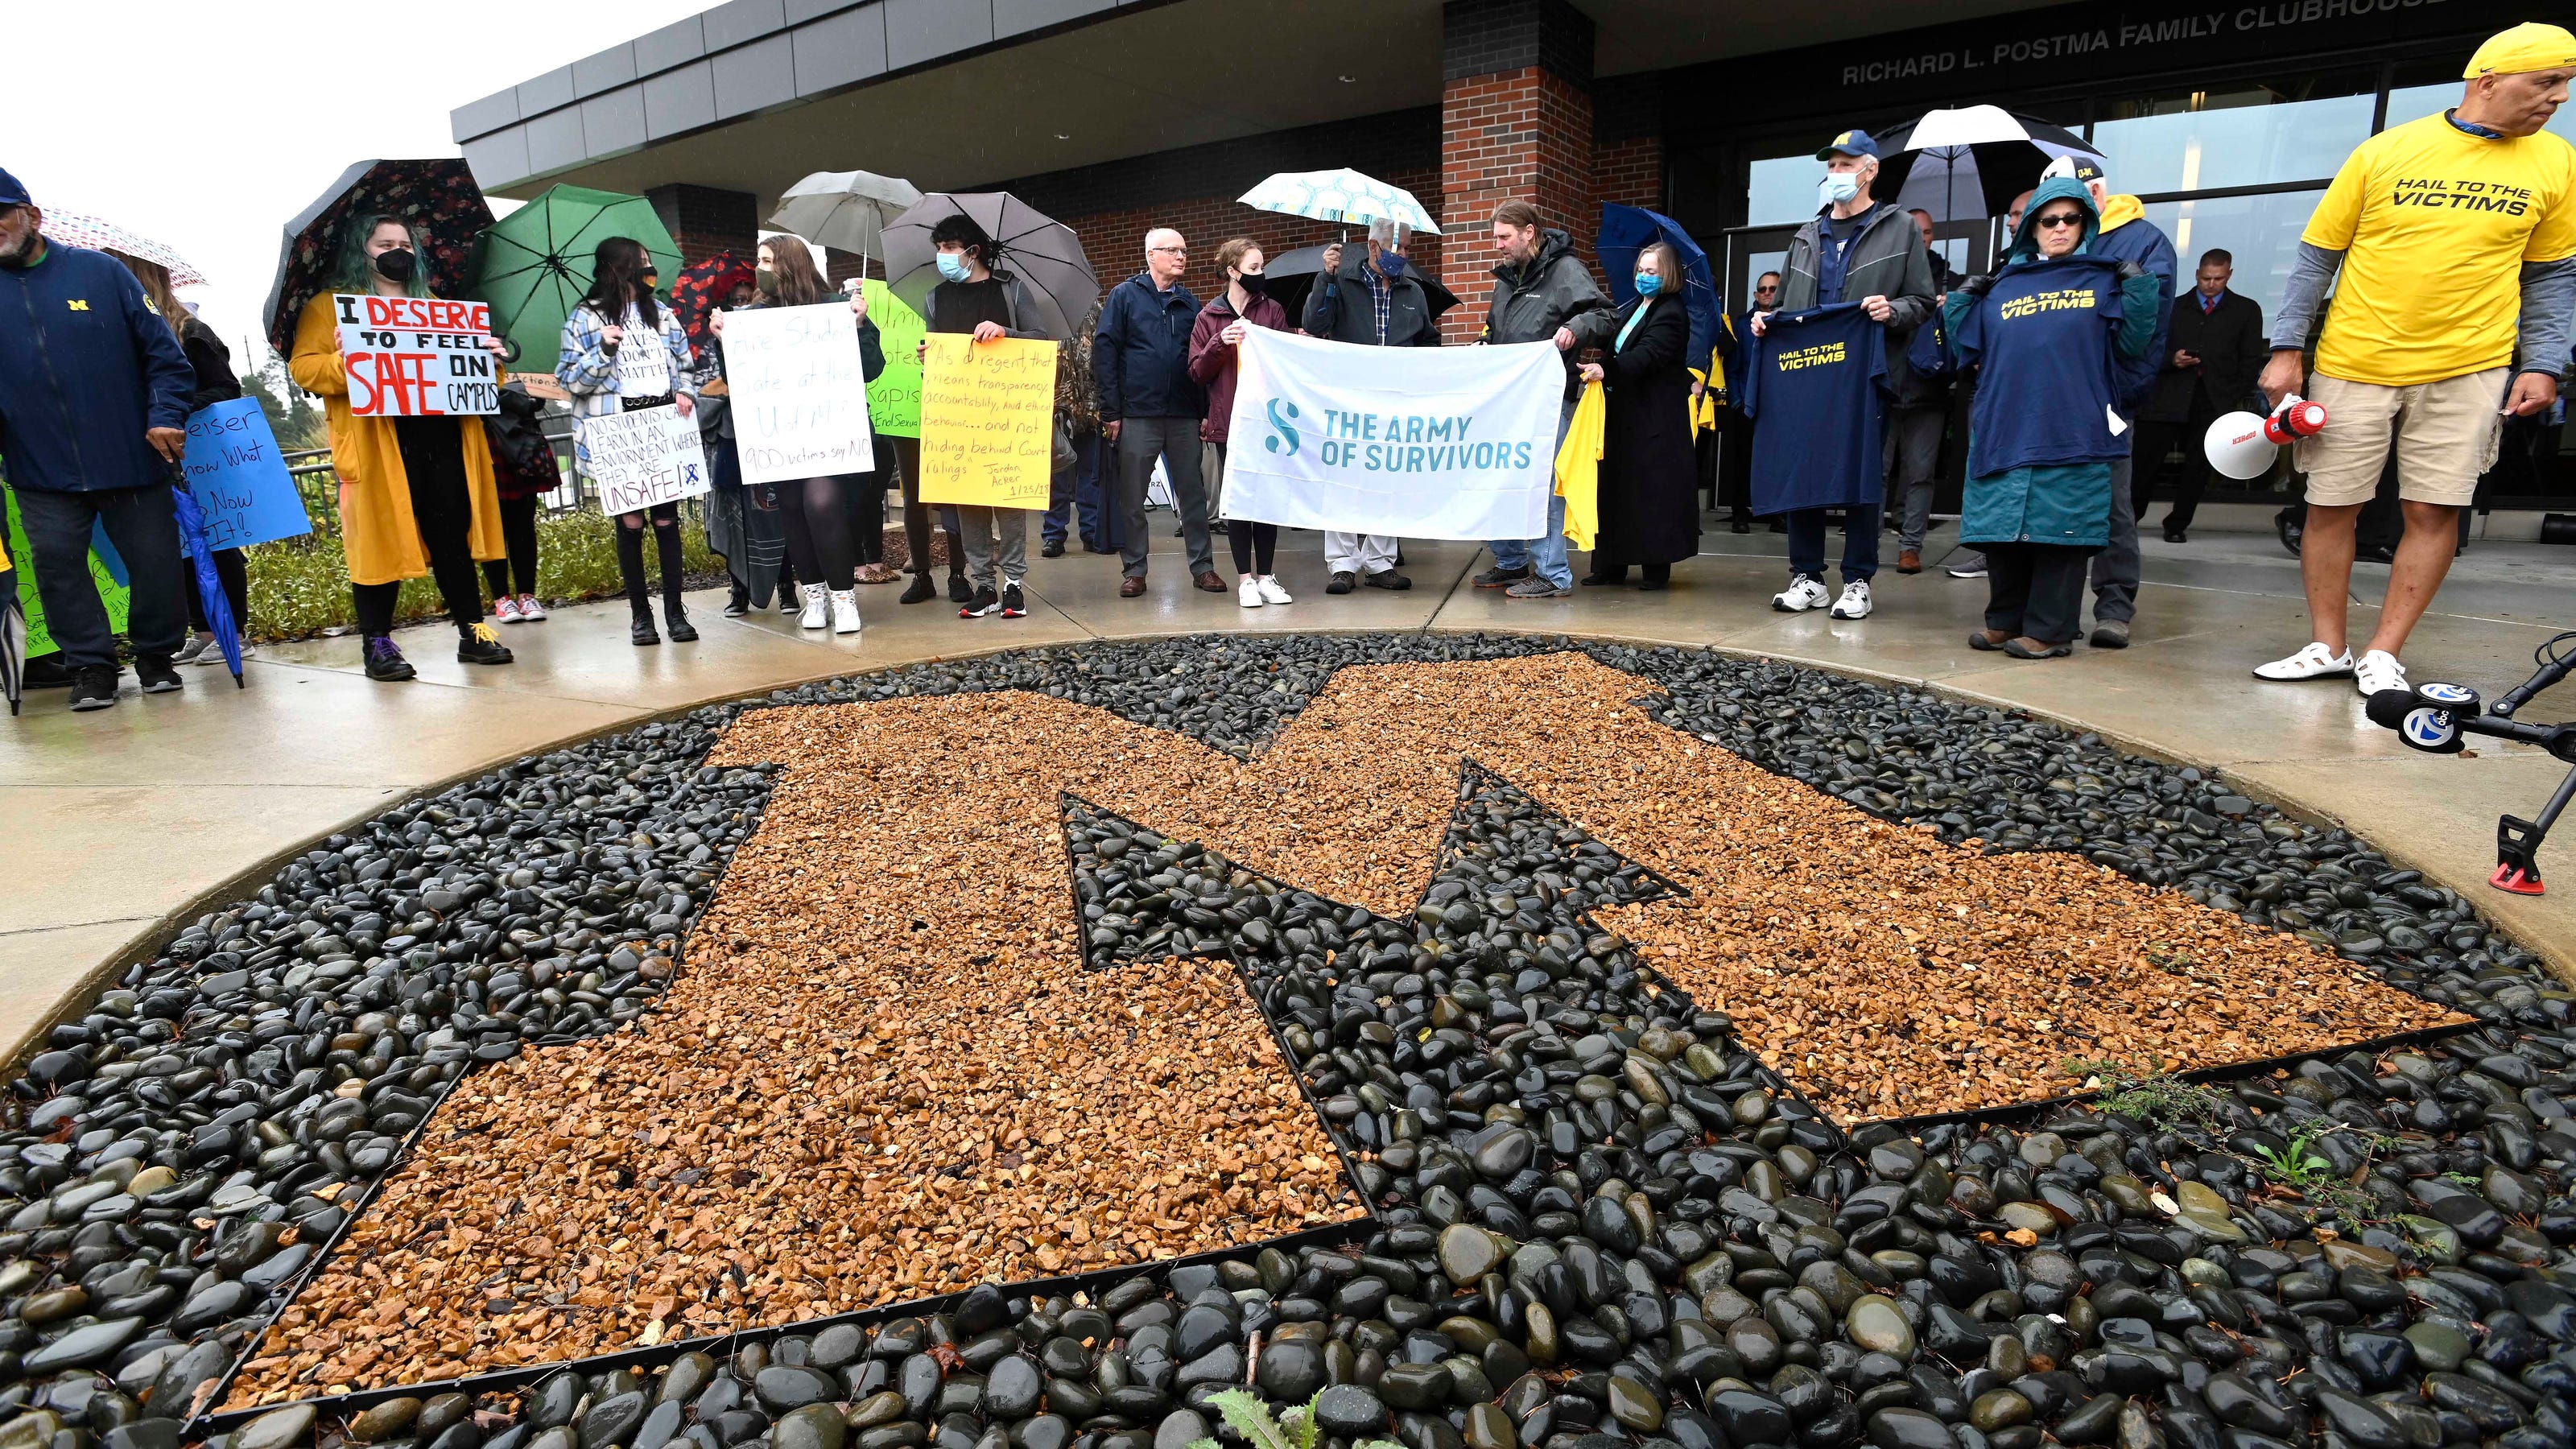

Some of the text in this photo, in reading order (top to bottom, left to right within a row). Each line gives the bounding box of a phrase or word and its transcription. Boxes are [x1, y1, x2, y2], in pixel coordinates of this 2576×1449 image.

[1842, 0, 2449, 85] RICHARD L. POSTMA FAMILY CLUBHOU
[2396, 179, 2532, 199] HAIL TO THE
[2393, 192, 2529, 217] VICTIMS
[67, 299, 90, 312] M
[2001, 290, 2094, 311] HAIL TO THE
[2001, 297, 2095, 320] VICTIMS
[336, 296, 490, 331] I DESERVE
[360, 331, 489, 349] TO FEEL
[621, 332, 658, 347] LIVES
[1778, 341, 1844, 361] HAIL TO THE
[618, 363, 668, 379] MATTE
[980, 348, 1028, 374] regent,
[1030, 350, 1053, 368] that
[1779, 350, 1846, 371] VICTIMS
[345, 352, 489, 416] SAFE ON
[865, 378, 920, 411] Rapis
[448, 382, 499, 412] CAMPUS
[188, 411, 258, 437] eiser
[609, 408, 661, 431] STUDENTS
[665, 407, 682, 419] CA
[985, 419, 1009, 431] and
[1016, 417, 1039, 434] not
[1325, 409, 1472, 443] THE ARMY
[590, 423, 665, 455] LEARN IN AN
[671, 431, 703, 451] WHERE
[923, 433, 965, 460] hiding
[2232, 431, 2256, 444] GOPHER
[183, 439, 264, 479] now What
[745, 437, 872, 473] 900 victims say NO
[1321, 441, 1532, 473] OF SURVIVORS
[597, 459, 661, 489] THEY ARE
[983, 463, 1022, 475] Jordan
[992, 475, 1021, 487] Acker
[1009, 484, 1050, 497] 1/25/18
[2437, 710, 2450, 726] abc
